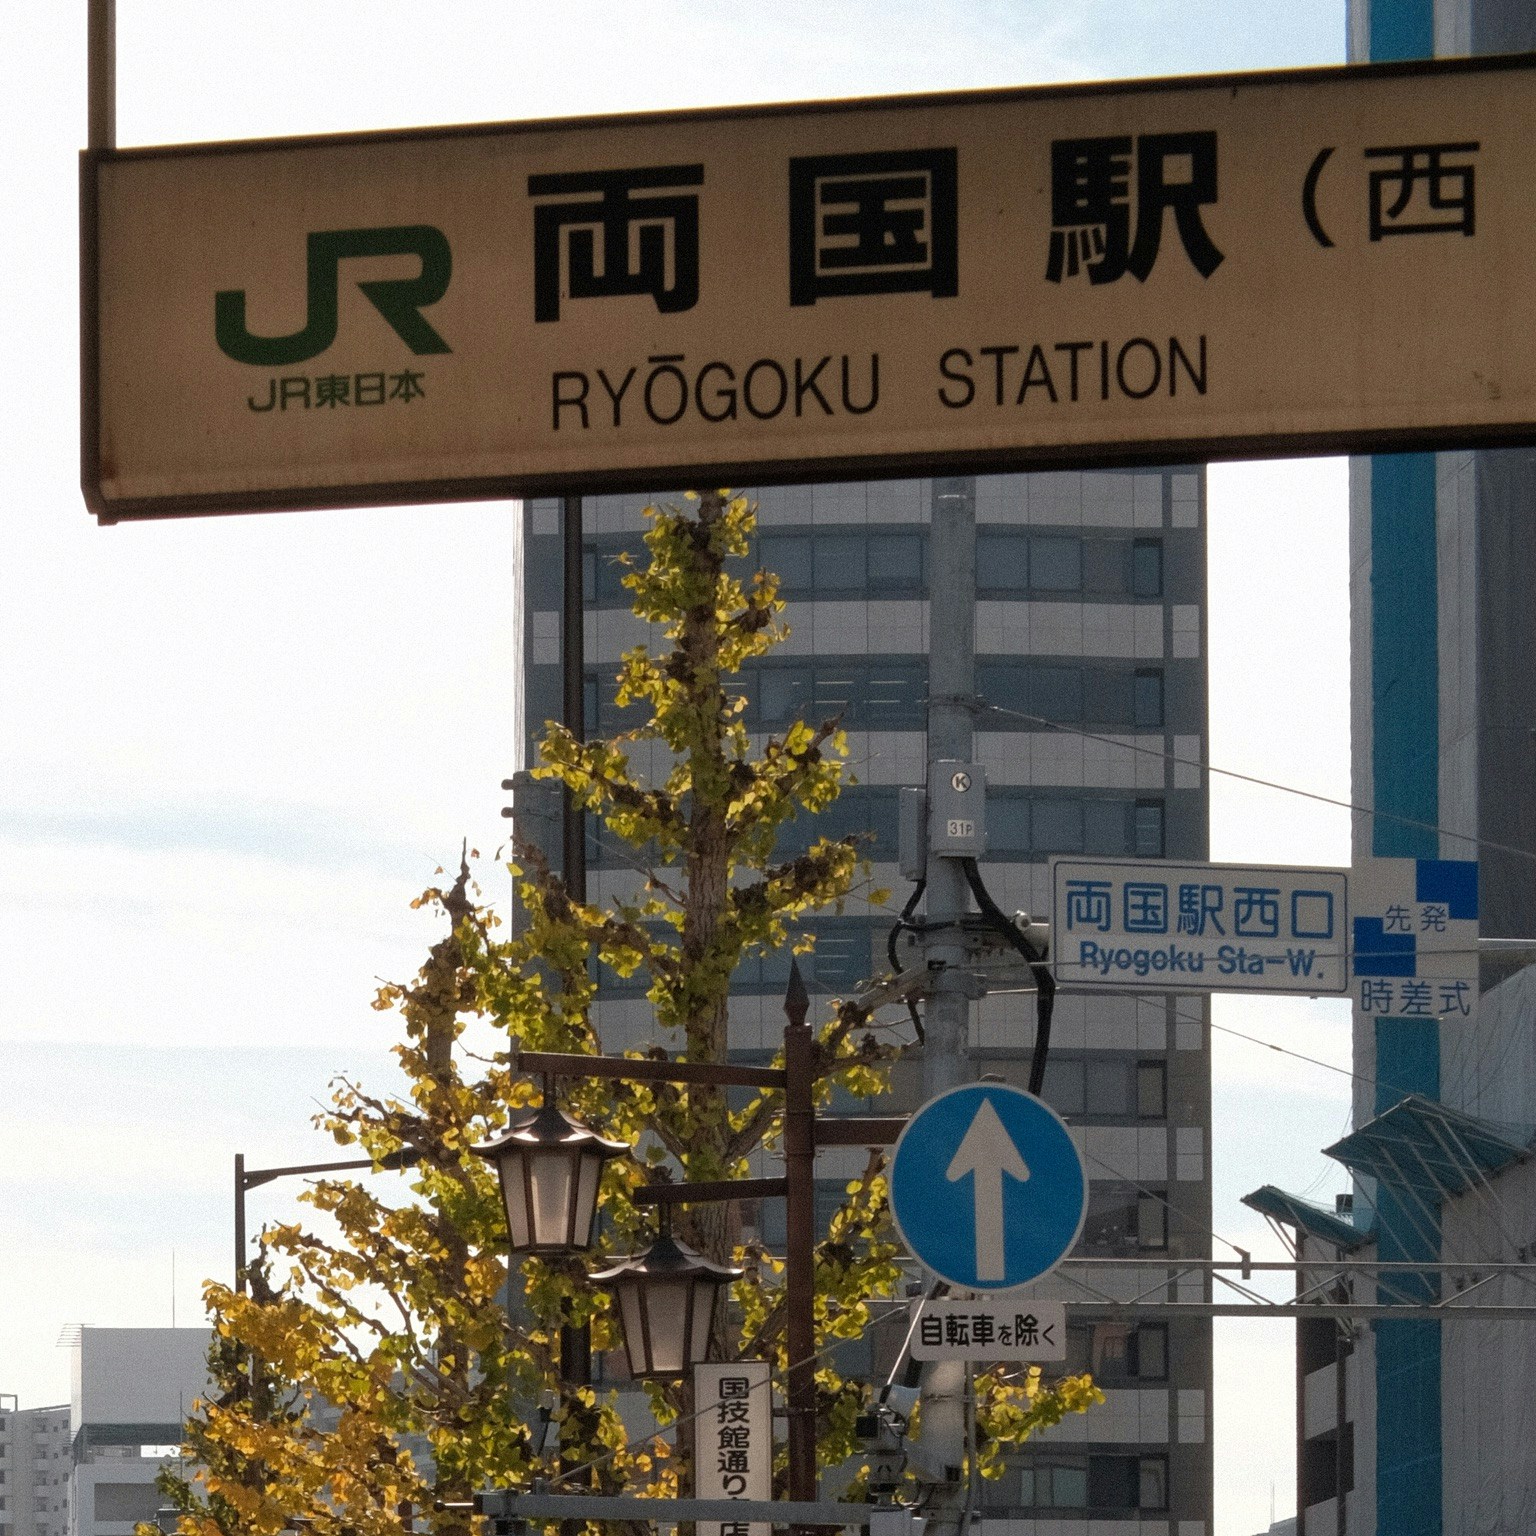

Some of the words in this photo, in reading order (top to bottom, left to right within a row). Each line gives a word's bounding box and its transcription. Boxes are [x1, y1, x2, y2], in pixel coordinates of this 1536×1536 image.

[214, 224, 453, 367] JR
[247, 368, 426, 412] JR東日本
[551, 353, 881, 431] RYŌGOKU
[937, 335, 1207, 409] STATION
[1065, 879, 1334, 939] 両国駅西口
[1079, 940, 1205, 976] Ryogoku
[1361, 979, 1470, 1016] 時差式
[920, 1313, 1056, 1347] 自転車を除く
